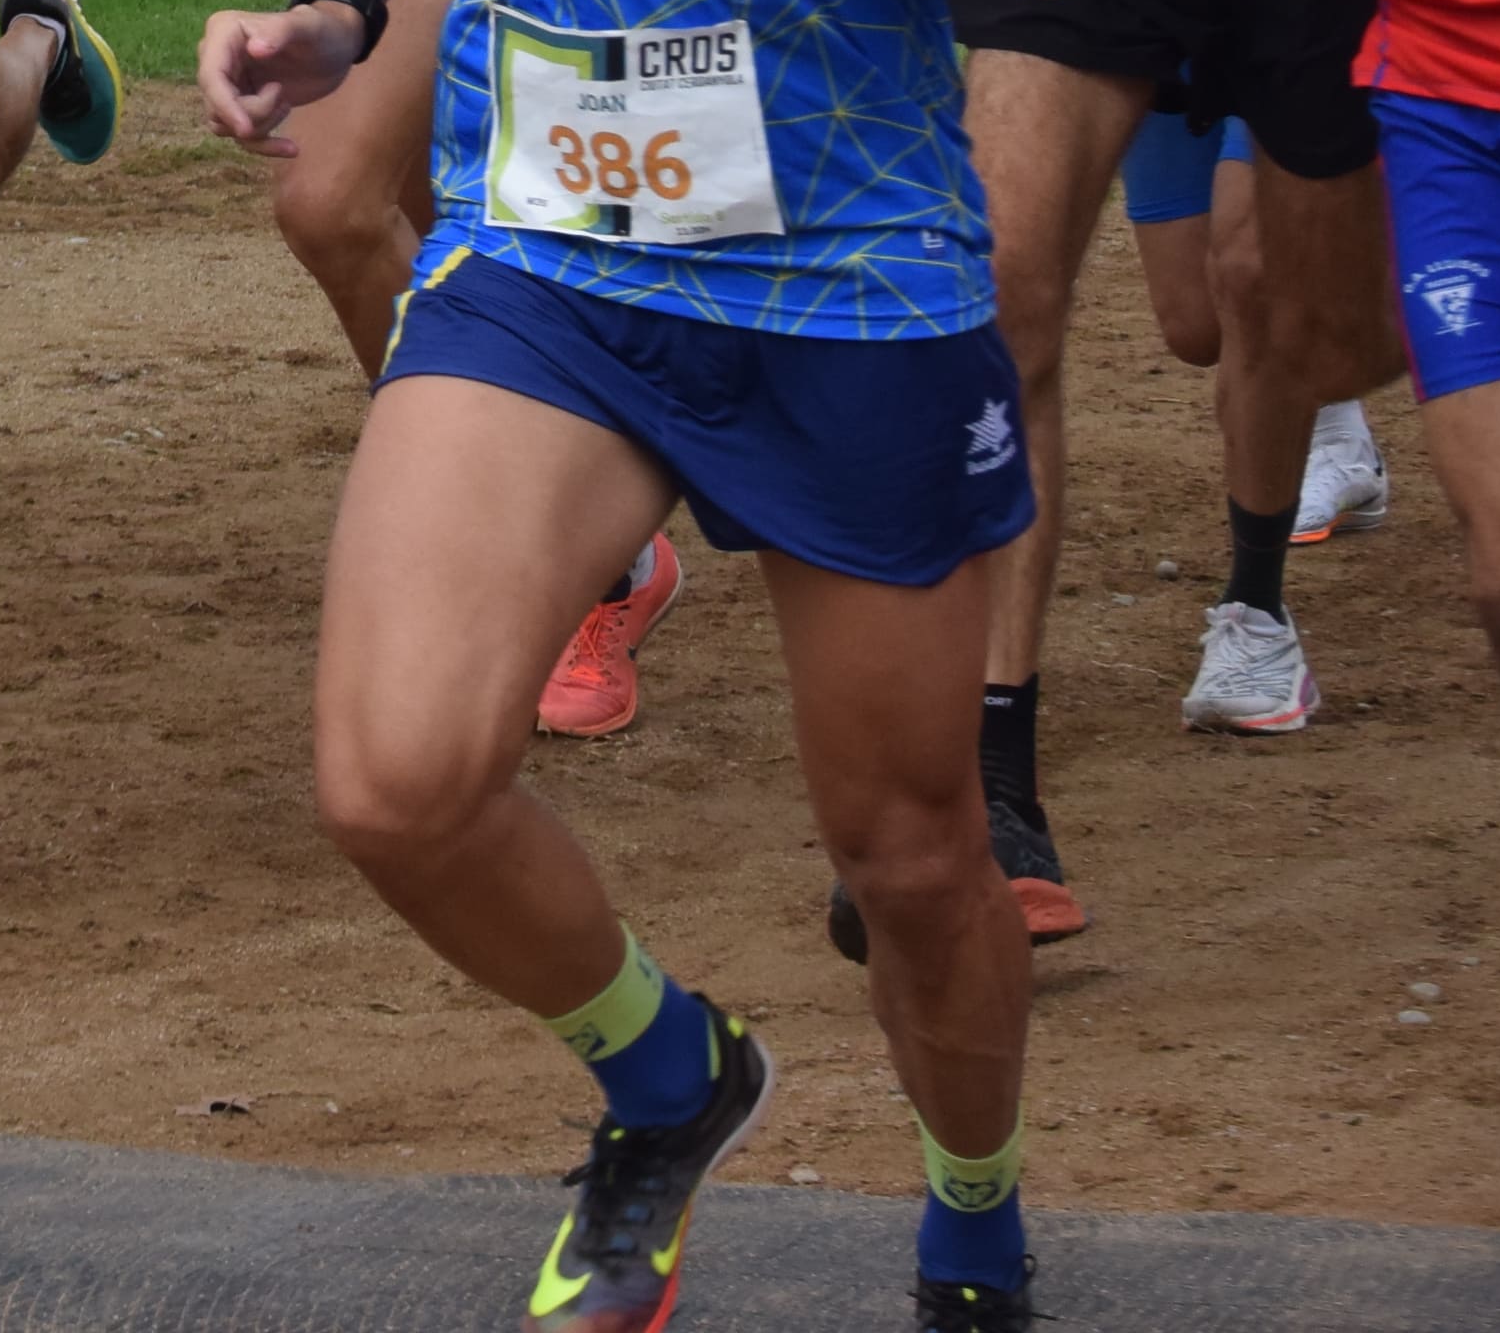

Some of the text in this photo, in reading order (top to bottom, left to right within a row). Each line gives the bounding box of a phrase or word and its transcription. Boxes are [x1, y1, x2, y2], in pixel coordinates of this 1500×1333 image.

[639, 32, 737, 78] CROS
[577, 94, 626, 113] JOAN
[549, 124, 692, 201] 386
